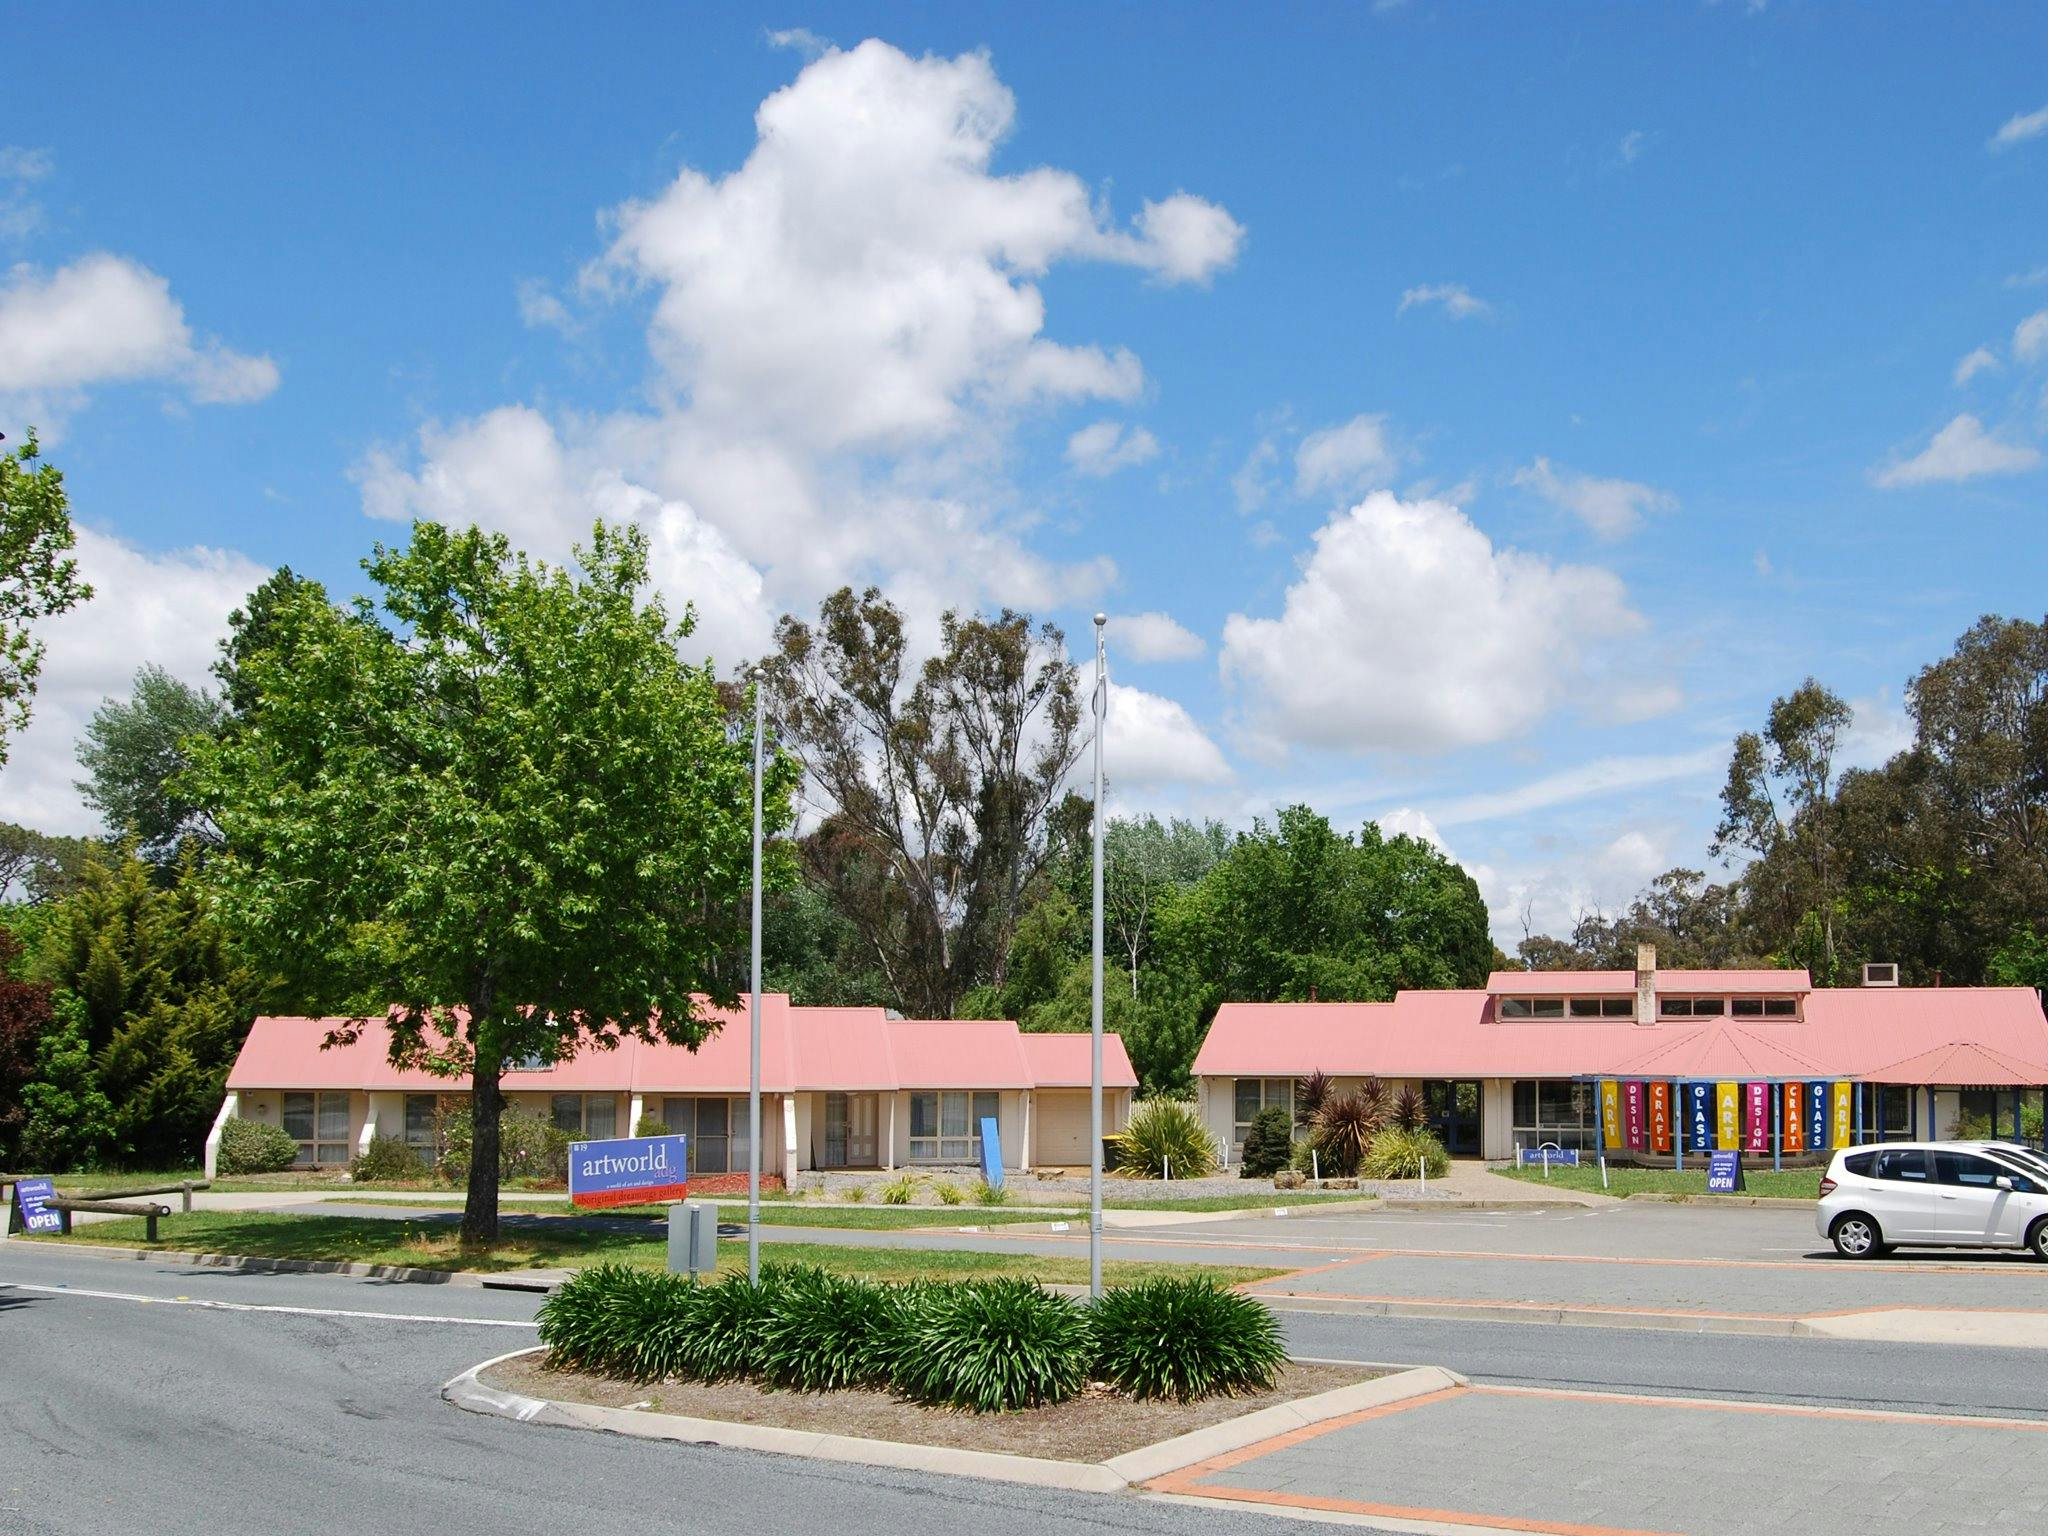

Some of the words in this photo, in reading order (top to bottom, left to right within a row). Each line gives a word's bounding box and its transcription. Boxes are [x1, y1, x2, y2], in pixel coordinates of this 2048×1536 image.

[1605, 1094, 1616, 1137] ART
[1629, 1085, 1639, 1144] DESIGN
[1654, 1086, 1664, 1147] CRAFT
[1694, 1086, 1706, 1147] GLASS
[1722, 1095, 1735, 1139] ART
[1753, 1086, 1763, 1147] DESIGN
[1789, 1085, 1797, 1146] CRAFT
[1814, 1085, 1823, 1146] GLASS
[1839, 1094, 1848, 1138] ART
[582, 1144, 667, 1176] artworld
[1710, 1177, 1733, 1188] OPEN
[28, 1213, 60, 1229] OPEN
